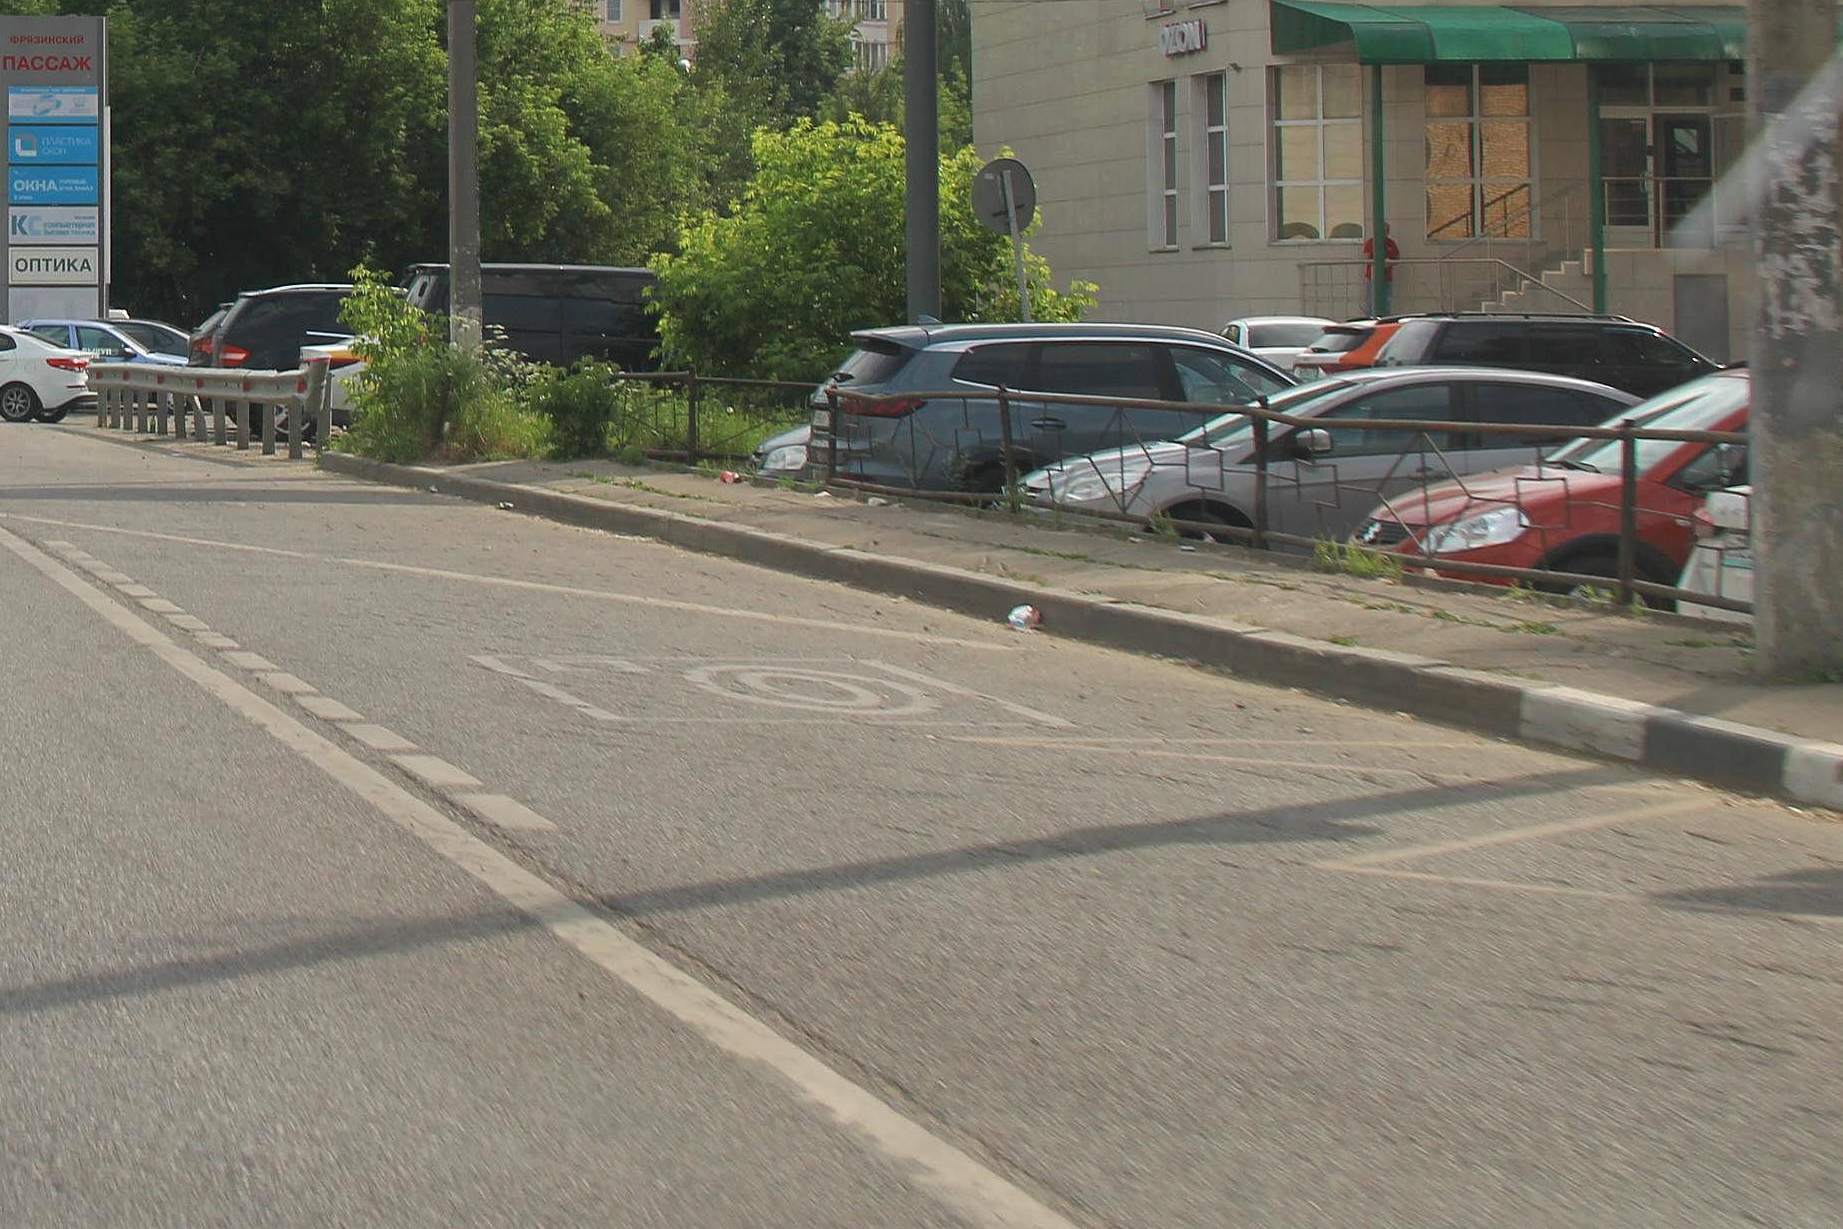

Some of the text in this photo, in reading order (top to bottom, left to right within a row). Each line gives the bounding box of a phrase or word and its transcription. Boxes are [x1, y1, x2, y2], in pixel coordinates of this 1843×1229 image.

[10, 34, 85, 44] ФРЯЗИНСКИЙ
[2, 55, 92, 71] ПАССАЖ
[14, 179, 58, 191] ОКНА
[15, 258, 92, 272] ОПТИКА
